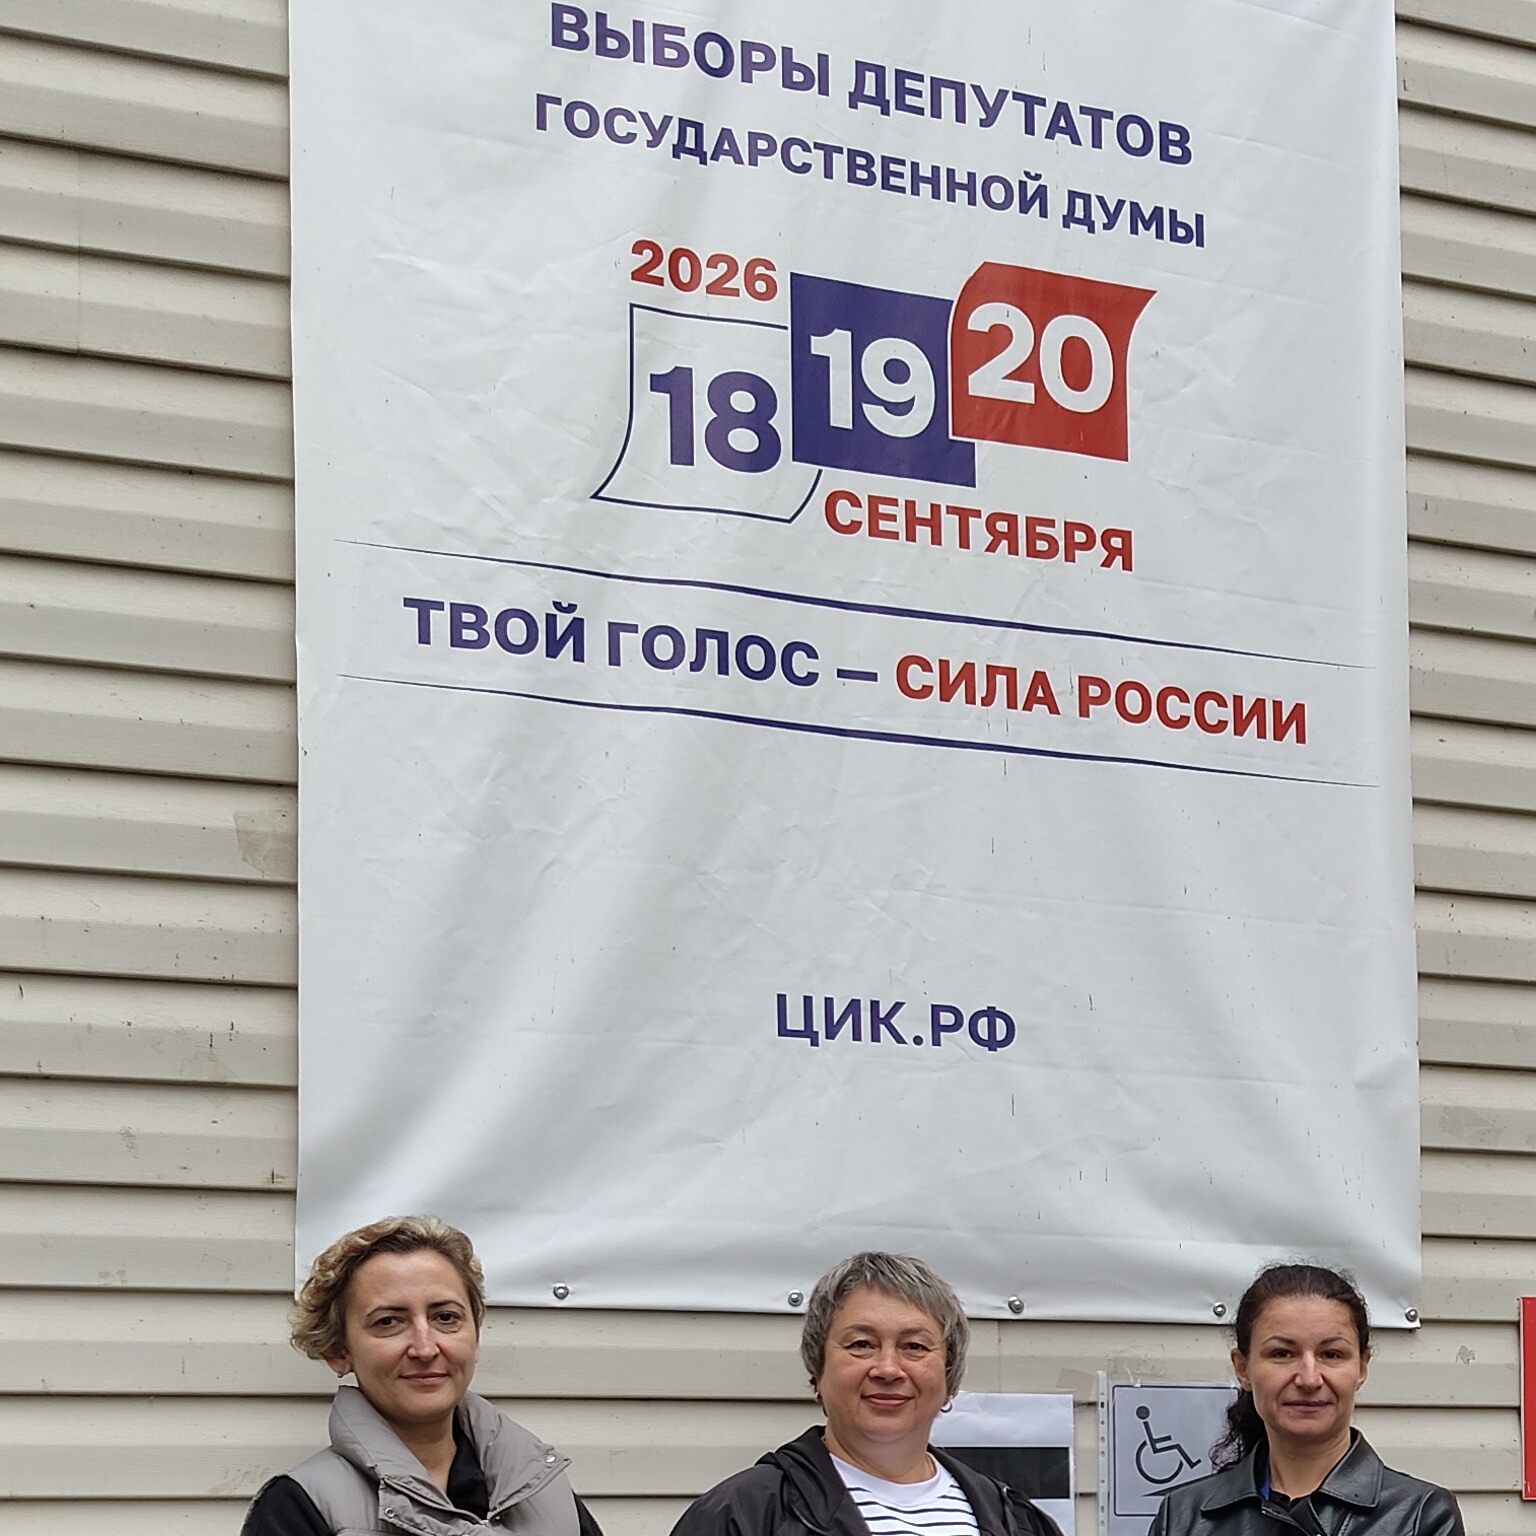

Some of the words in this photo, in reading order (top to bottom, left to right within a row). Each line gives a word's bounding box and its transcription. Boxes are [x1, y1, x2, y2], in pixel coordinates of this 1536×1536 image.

[551, 2, 830, 97] ВЫБОРЫ
[848, 59, 1192, 165] ДЕПУТАТОВ
[535, 93, 1048, 219] ГОСУДАРСТВЕННОЙ
[1062, 190, 1205, 248] ДУМЫ
[630, 239, 778, 301] 2026
[650, 367, 782, 473] 18
[809, 327, 937, 439] 19
[966, 302, 1115, 413] 20
[824, 489, 1134, 572] СЕНТЯБРЯ
[402, 597, 585, 663] ТВОЙ
[607, 621, 820, 687] ГОЛОС
[895, 653, 1060, 717] СИЛА
[1077, 674, 1307, 745] РОССИИ
[776, 993, 1016, 1052] ЦИК.РФ
